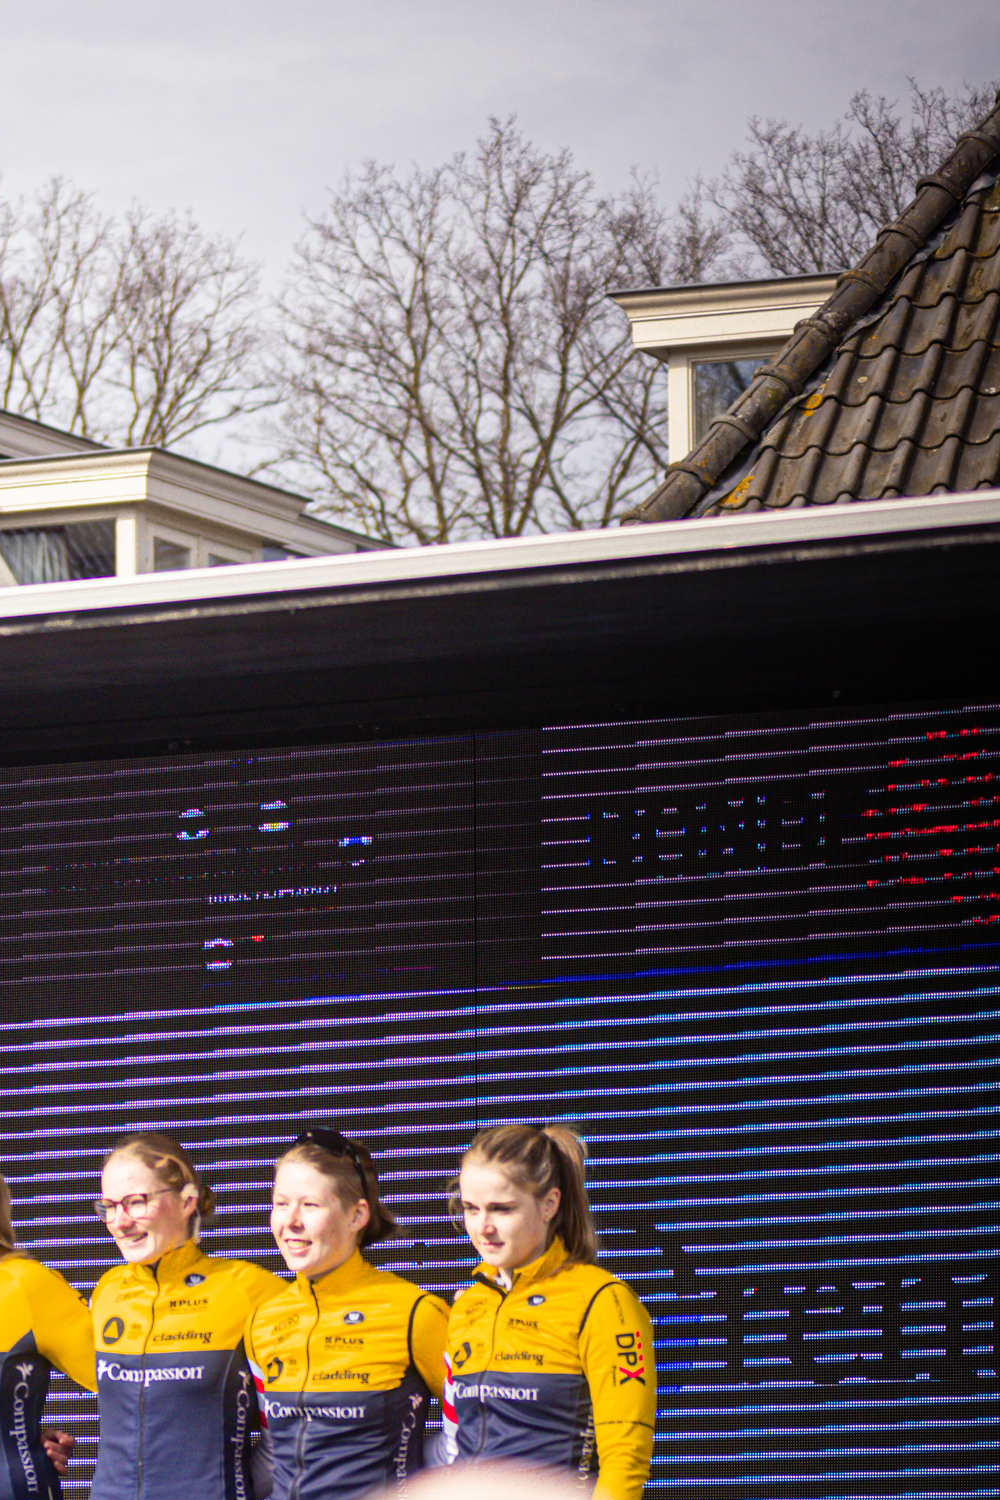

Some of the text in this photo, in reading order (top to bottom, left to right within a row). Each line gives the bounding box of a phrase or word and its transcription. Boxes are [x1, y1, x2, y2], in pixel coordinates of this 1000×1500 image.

[152, 1330, 213, 1344] cladding
[615, 1332, 646, 1387] DPX
[107, 1363, 205, 1387] Compassion
[455, 1381, 540, 1403] Compassion
[269, 1400, 367, 1422] Compassion
[10, 1381, 40, 1493] Compassion
